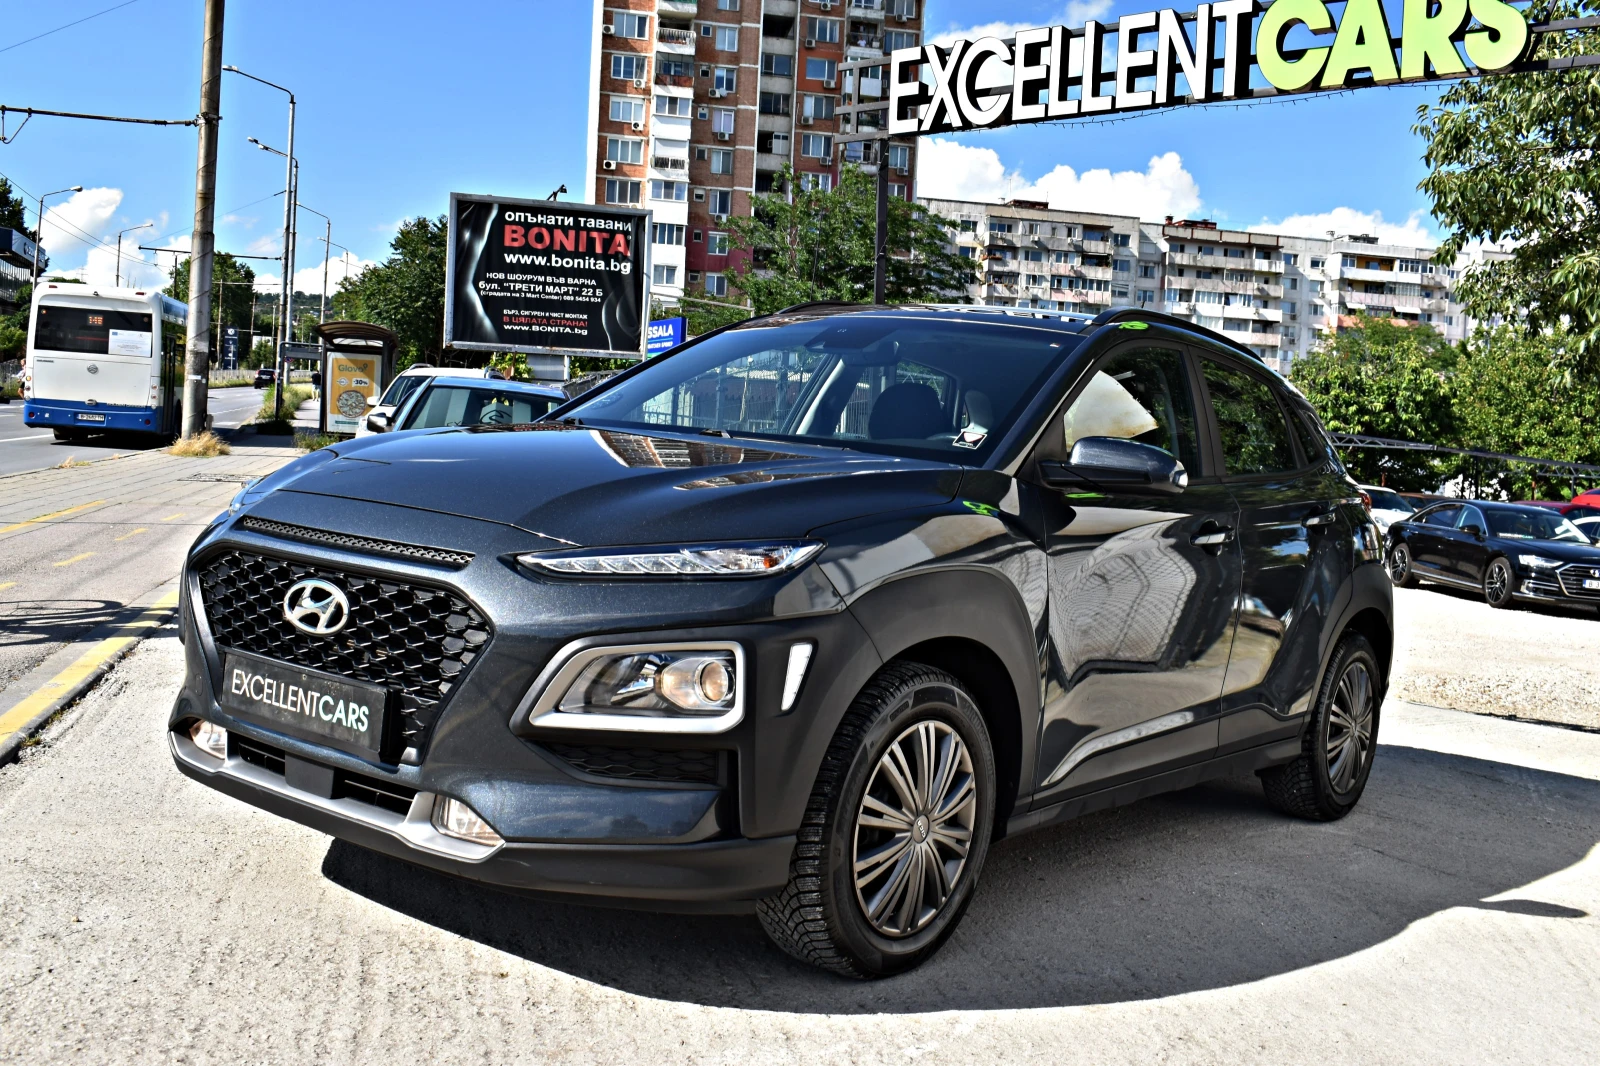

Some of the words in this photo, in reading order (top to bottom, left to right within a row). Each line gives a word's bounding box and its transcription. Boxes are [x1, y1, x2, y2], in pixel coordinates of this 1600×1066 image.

[505, 211, 574, 226] опънати
[578, 217, 632, 231] тавани
[504, 224, 630, 256] BONITA
[504, 253, 631, 274] www.bonita.bg
[486, 272, 505, 280] НОВ
[507, 274, 545, 282] ШОУРУМ
[546, 276, 565, 284] ВЪВ
[567, 278, 596, 286] ВАРНА
[478, 281, 500, 290] бул.
[582, 288, 593, 296] 22
[512, 316, 547, 325] ЦЯЛАТА
[550, 319, 588, 327] СТРАНА!
[503, 325, 588, 335] www.BONITA.bg
[648, 324, 673, 338] SSALA
